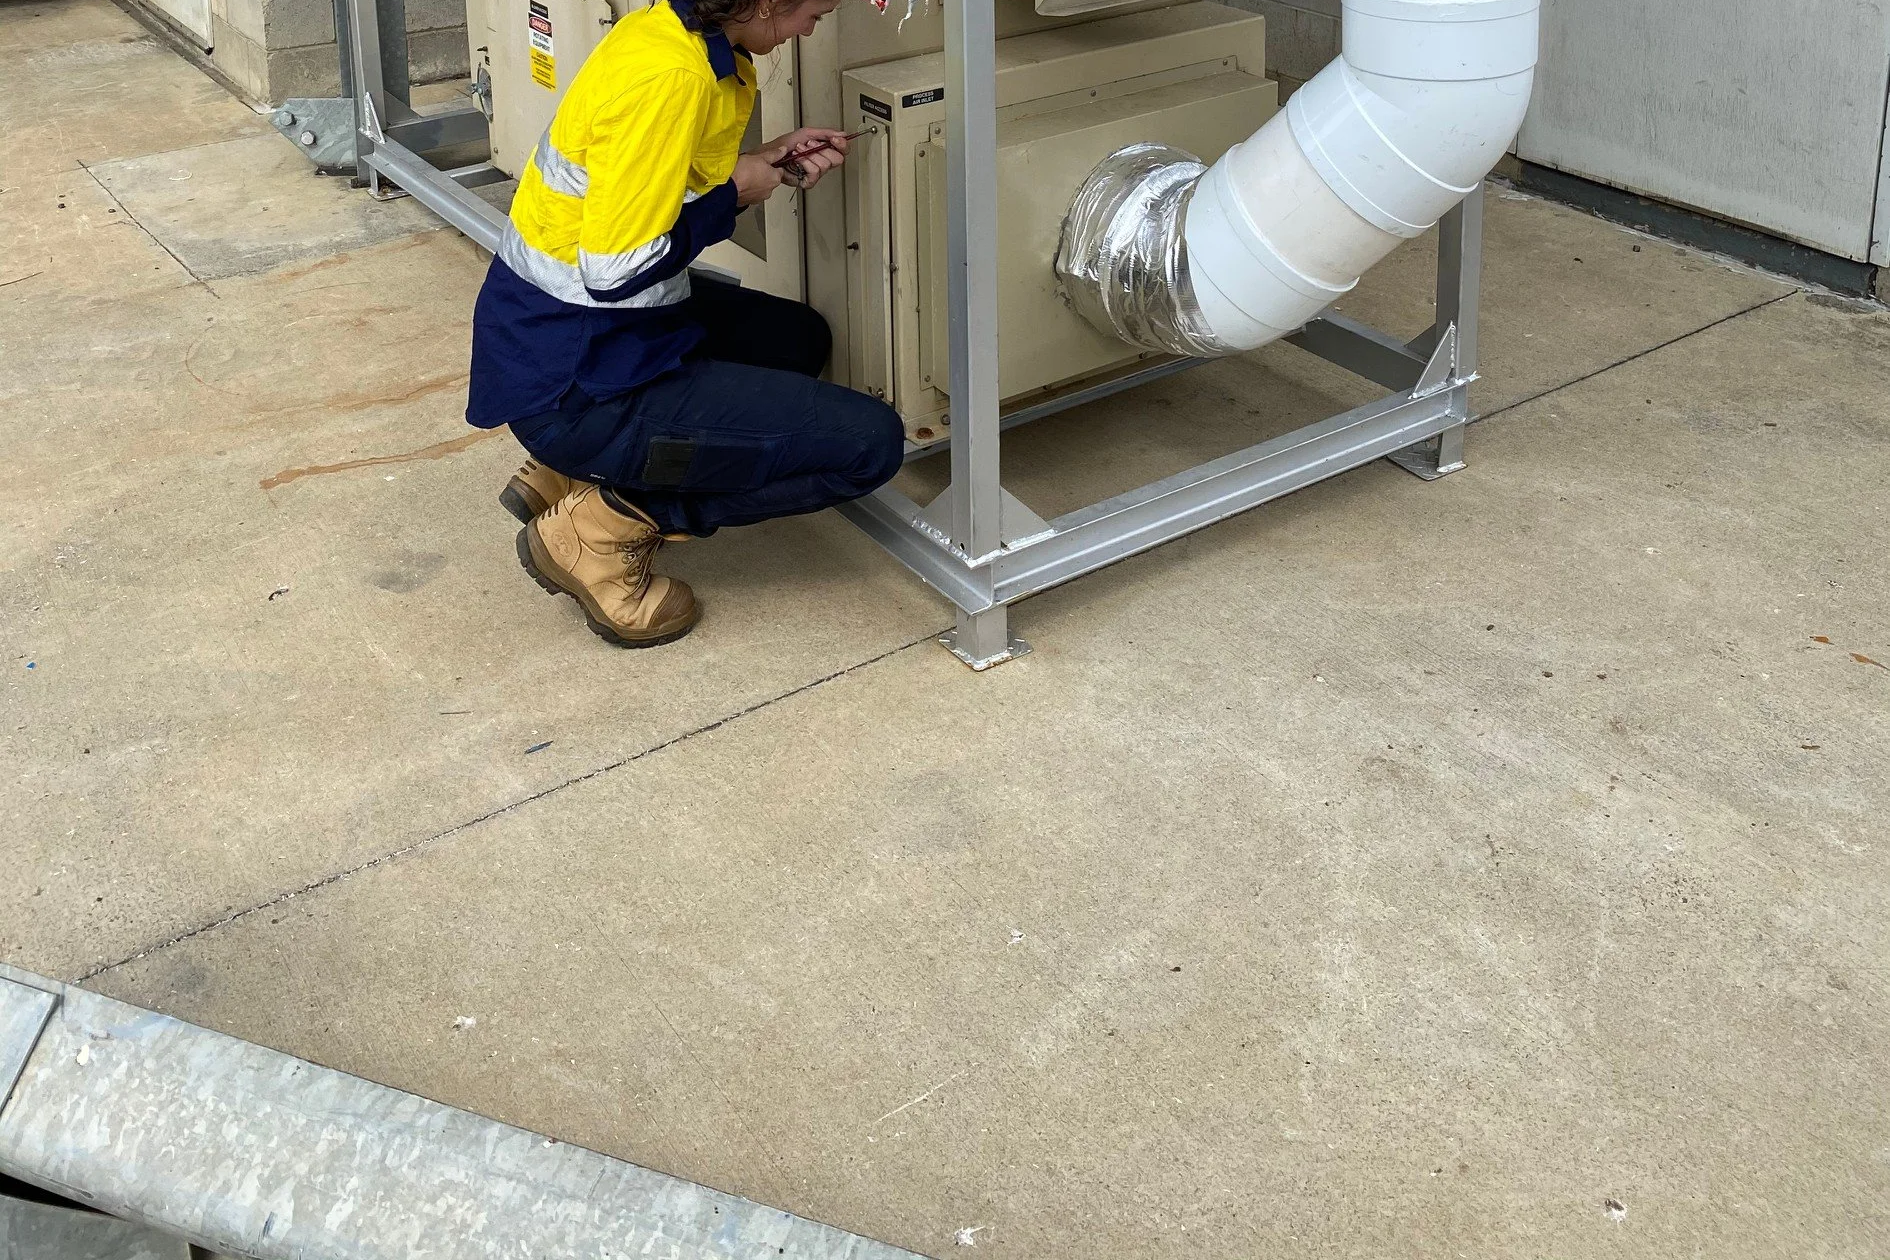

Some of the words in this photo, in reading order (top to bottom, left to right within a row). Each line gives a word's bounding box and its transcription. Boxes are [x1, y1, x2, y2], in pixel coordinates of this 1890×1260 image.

[532, 19, 548, 31] DANGER
[912, 91, 934, 99] PROCESS
[875, 106, 887, 114] ACCESS
